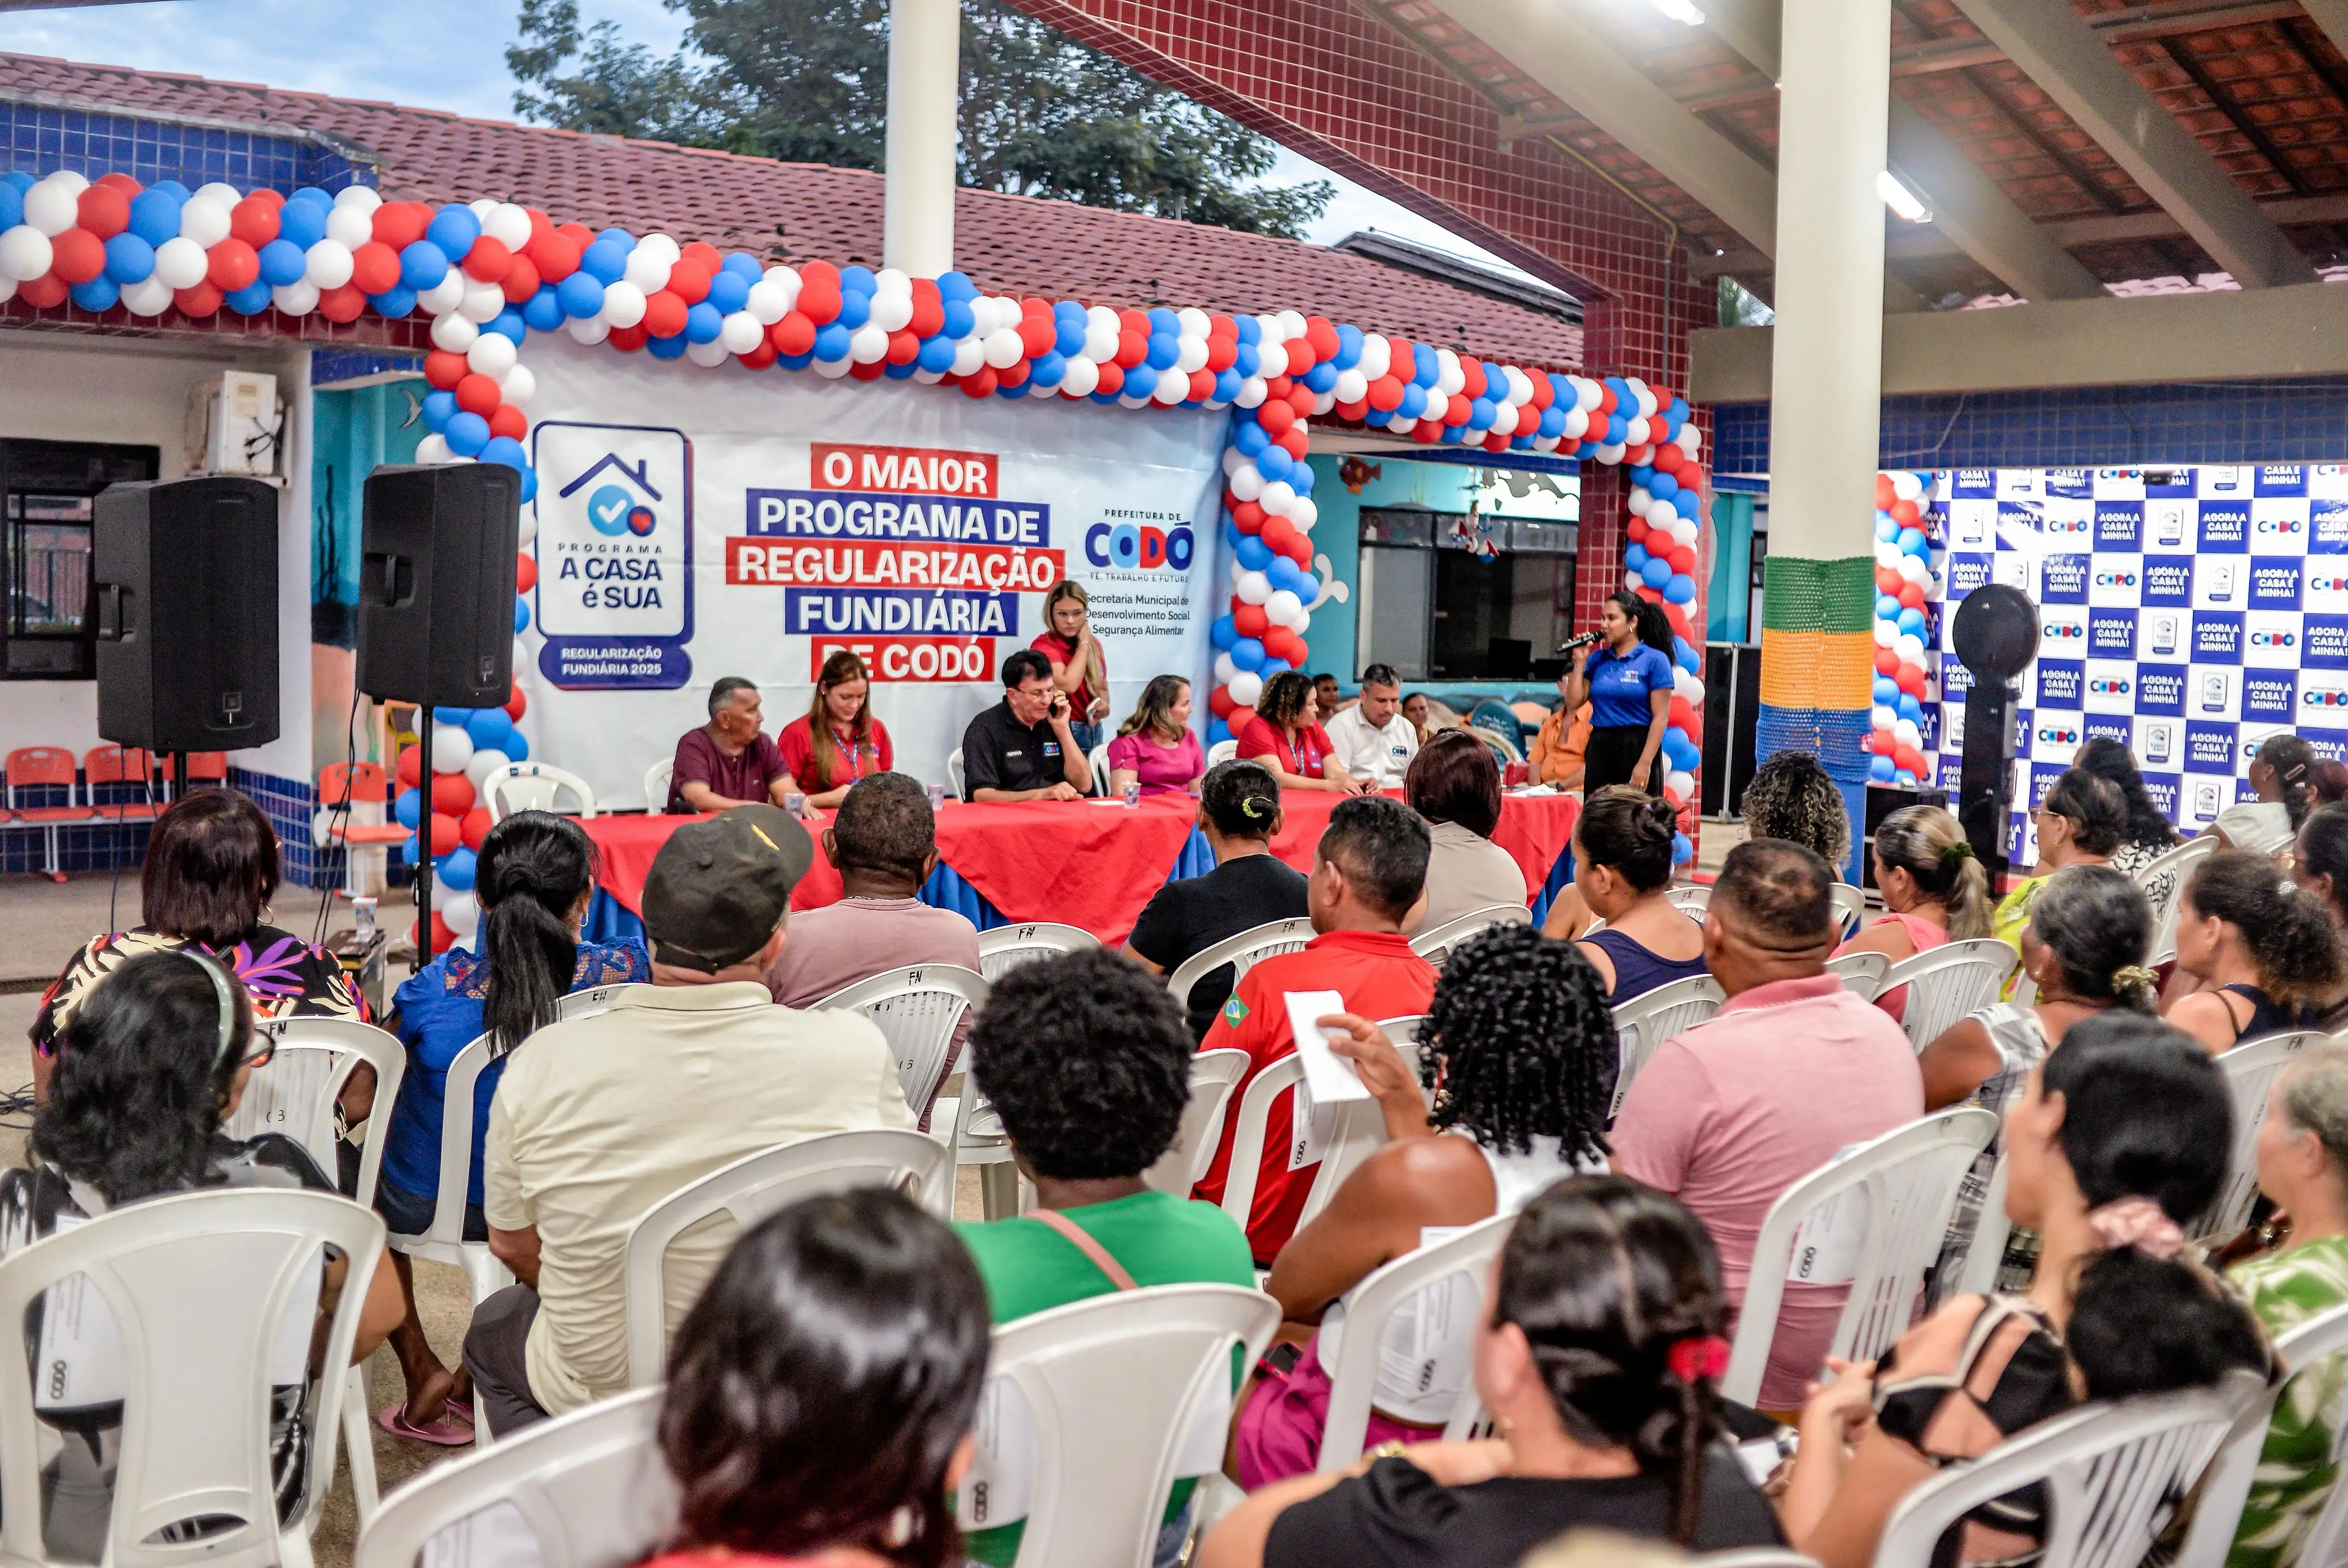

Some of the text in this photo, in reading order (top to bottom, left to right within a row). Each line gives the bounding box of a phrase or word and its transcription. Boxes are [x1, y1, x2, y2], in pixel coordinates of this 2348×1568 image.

[824, 452, 988, 494] O MAIOR
[1105, 509, 1164, 520] PREFEITURA
[2134, 513, 2140, 522] A
[2239, 513, 2246, 522] A
[759, 497, 1040, 544] PROGRAMA DE
[558, 542, 663, 554] PROGRAMA
[1085, 521, 1194, 571] CODÓ
[560, 557, 663, 580] A CASA
[738, 546, 1056, 595] REGULARIZAÇÃO
[2079, 566, 2086, 575] A
[2181, 567, 2189, 577] A
[2291, 569, 2299, 578] A
[1106, 573, 1149, 581] TRABALHO
[583, 582, 663, 608] é SUA
[1087, 593, 1132, 605] Secretaria
[1136, 594, 1179, 607] Municipal
[799, 587, 1007, 633] FUNDIÁRIA
[1086, 610, 1190, 620] Desenvolvimento Social
[2127, 620, 2134, 629] A
[2197, 623, 2240, 633] AGORA A
[1093, 625, 1184, 637] Segurança Alimentar
[2308, 627, 2345, 637] AGORA
[2201, 632, 2228, 642] CASA
[2312, 637, 2341, 646] CASA
[2200, 641, 2235, 652] MINHA!
[560, 646, 662, 662] REGULARIZAÇÃO
[823, 636, 985, 678] E CODÓ
[563, 662, 662, 674] FUNDIÁRIA 2025
[2073, 671, 2080, 681] A
[2141, 675, 2183, 686] AGORA A
[2145, 684, 2171, 694] CASA
[2249, 681, 2292, 691] AGORA A
[2144, 693, 2178, 704] MINHA!
[2253, 690, 2280, 700] CASA
[2251, 700, 2287, 710] MINHA!
[2191, 733, 2233, 744] AGORA A
[2195, 742, 2221, 752] CASA
[2194, 751, 2228, 763] MINHA!
[1018, 926, 1036, 940] FN
[909, 970, 922, 986] FN
[269, 1020, 287, 1036] FN
